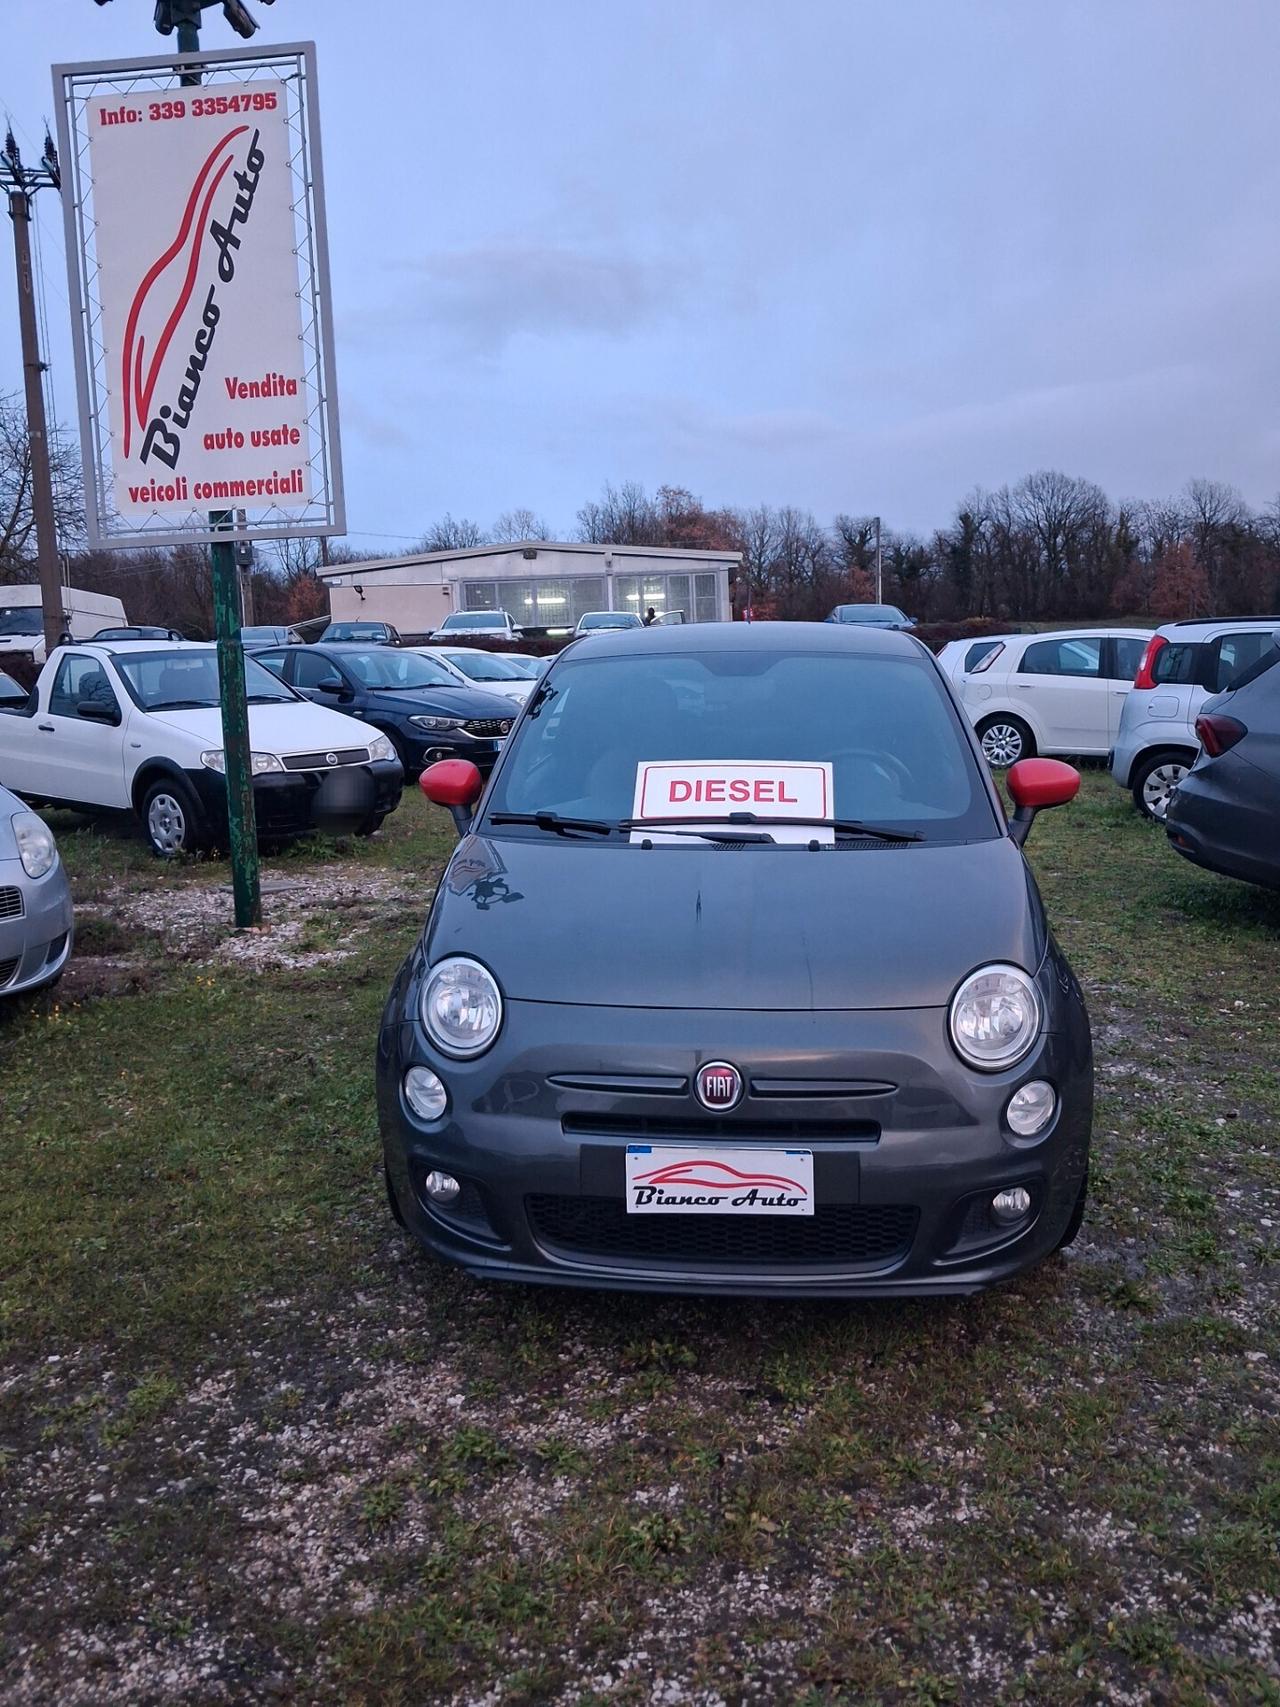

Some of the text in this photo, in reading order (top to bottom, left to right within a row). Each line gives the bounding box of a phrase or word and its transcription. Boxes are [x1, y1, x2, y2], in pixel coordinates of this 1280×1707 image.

[100, 92, 277, 126] Info: 339 3354795
[140, 128, 265, 470] Bianco Auto
[225, 372, 297, 400] Vendita
[203, 424, 301, 450] auto usate
[128, 469, 303, 503] veicoli commerciali
[669, 780, 798, 803] DIESEL
[706, 1076, 733, 1097] FIAT
[633, 1185, 807, 1207] Bianco Auto
